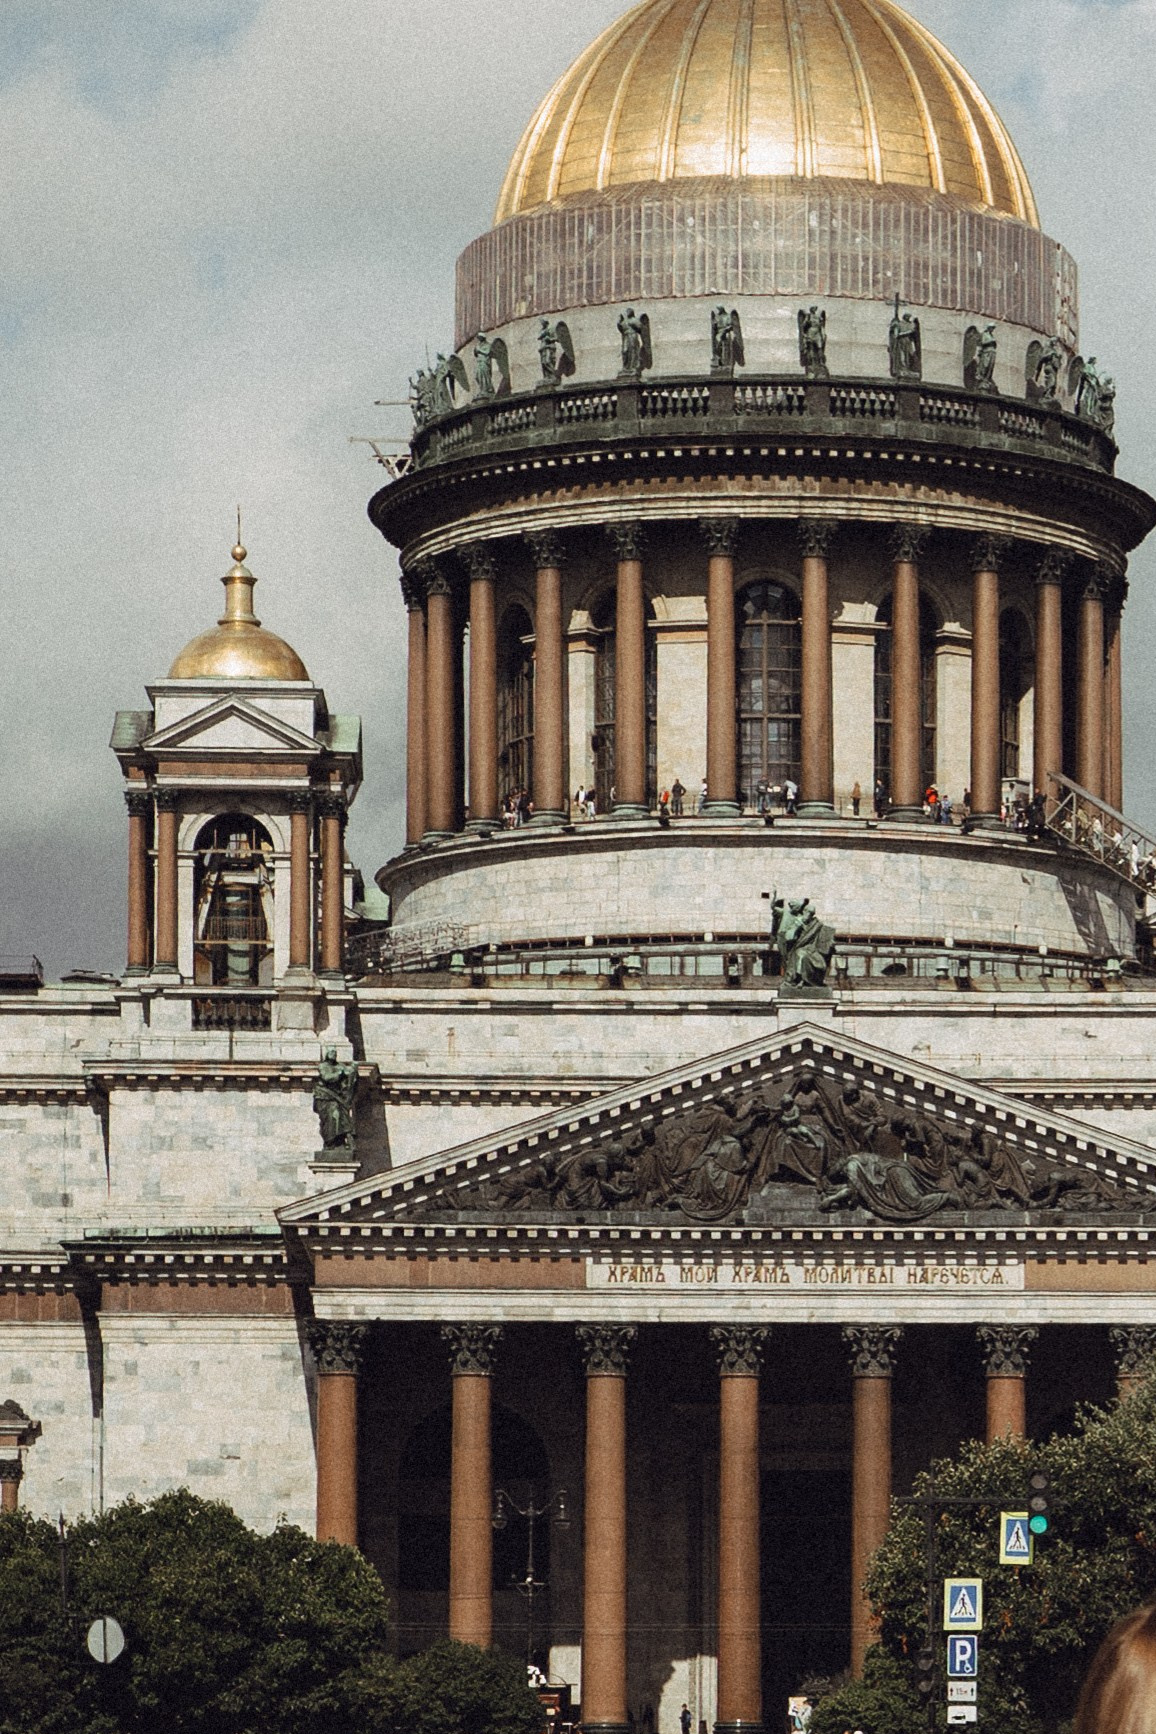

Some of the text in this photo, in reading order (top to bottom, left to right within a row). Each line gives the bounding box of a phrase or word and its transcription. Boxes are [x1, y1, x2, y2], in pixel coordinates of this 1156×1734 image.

[608, 1264, 666, 1283] ХРАМЪ
[731, 1264, 791, 1284] ХРАМЪ
[956, 1640, 971, 1671] P
